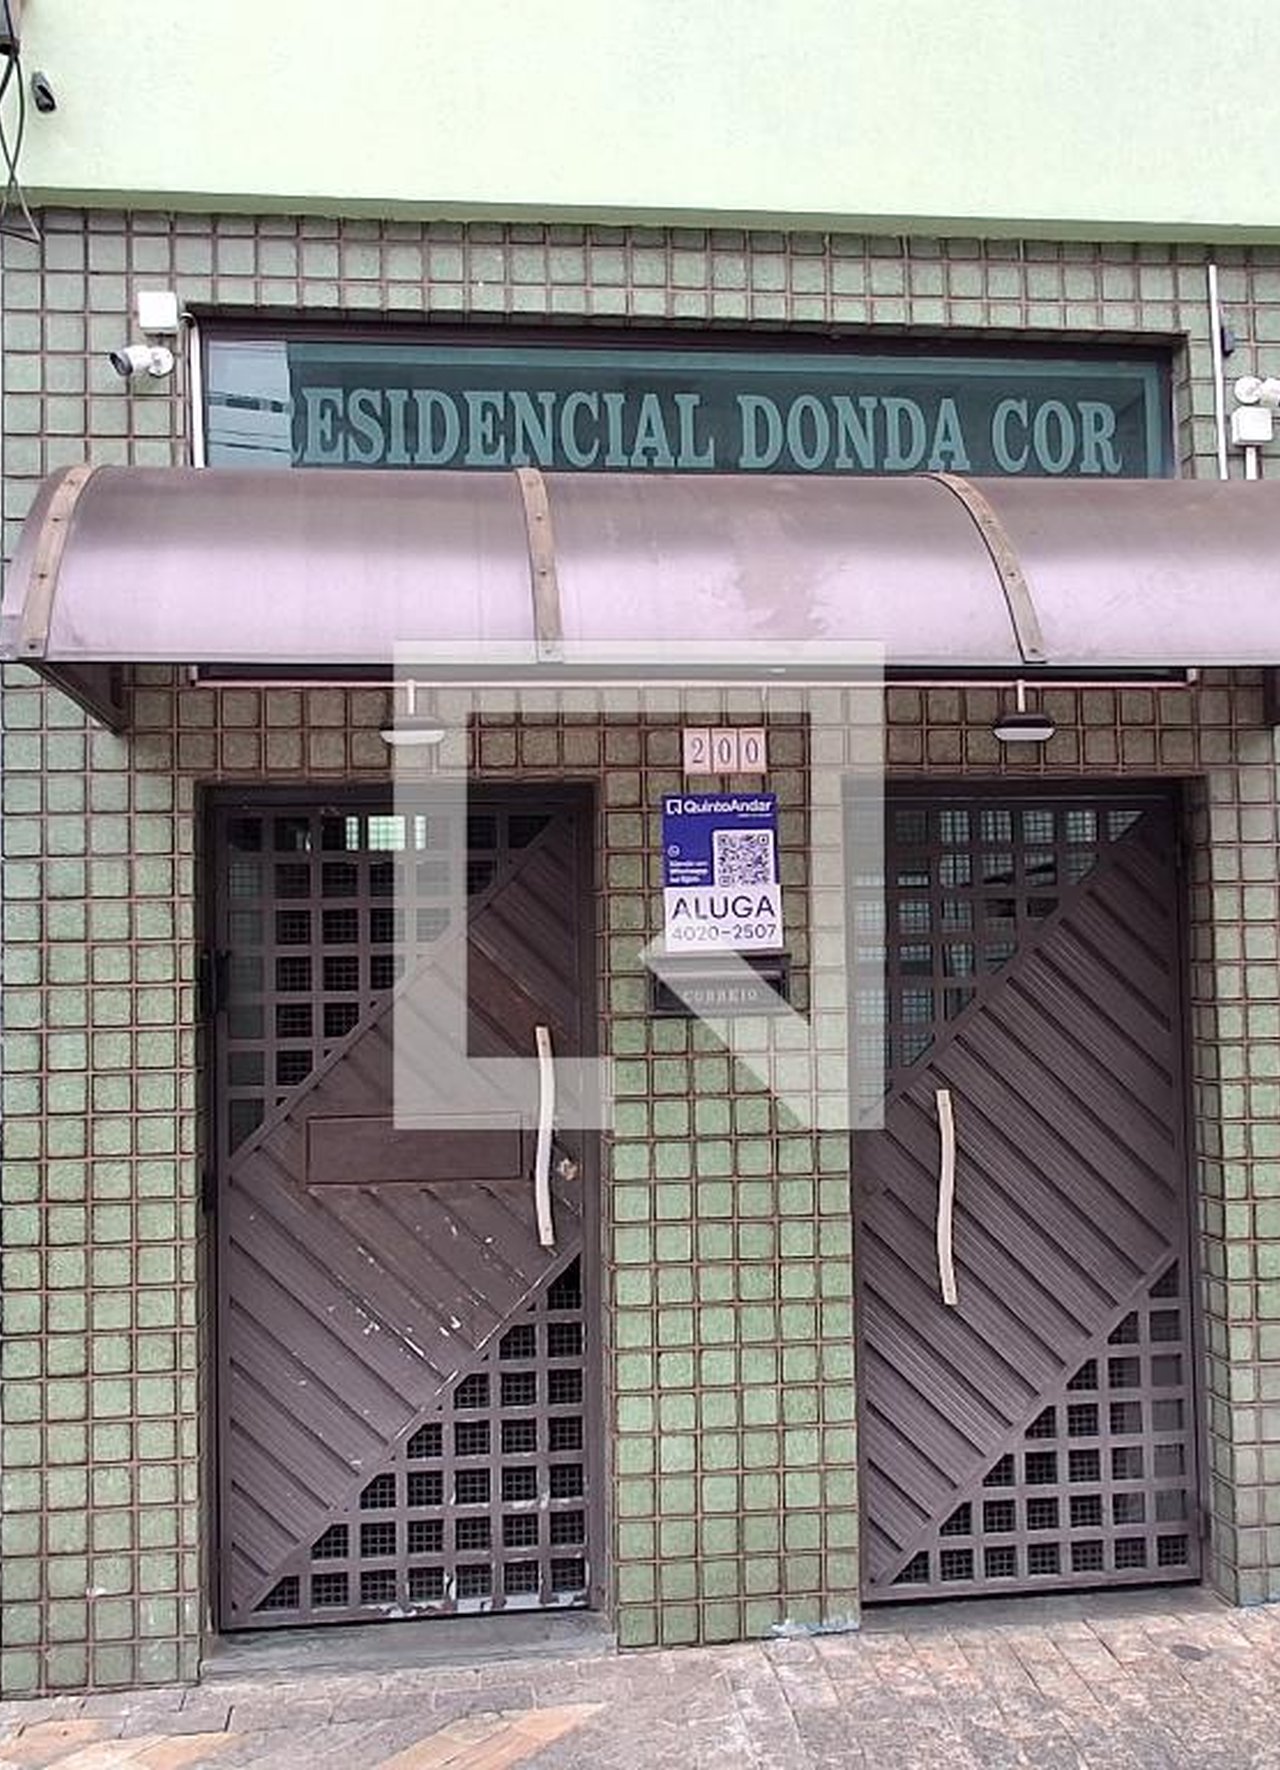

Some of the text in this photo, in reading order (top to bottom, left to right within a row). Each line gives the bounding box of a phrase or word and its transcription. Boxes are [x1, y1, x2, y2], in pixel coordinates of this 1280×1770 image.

[291, 387, 1123, 473] ESIDENCIAL DONDA COR
[691, 737, 758, 763] 200
[683, 799, 772, 812] QuintoAndar
[672, 896, 775, 919] ALUGA
[672, 924, 776, 941] 4020-2507
[682, 988, 757, 1002] CORREIO
